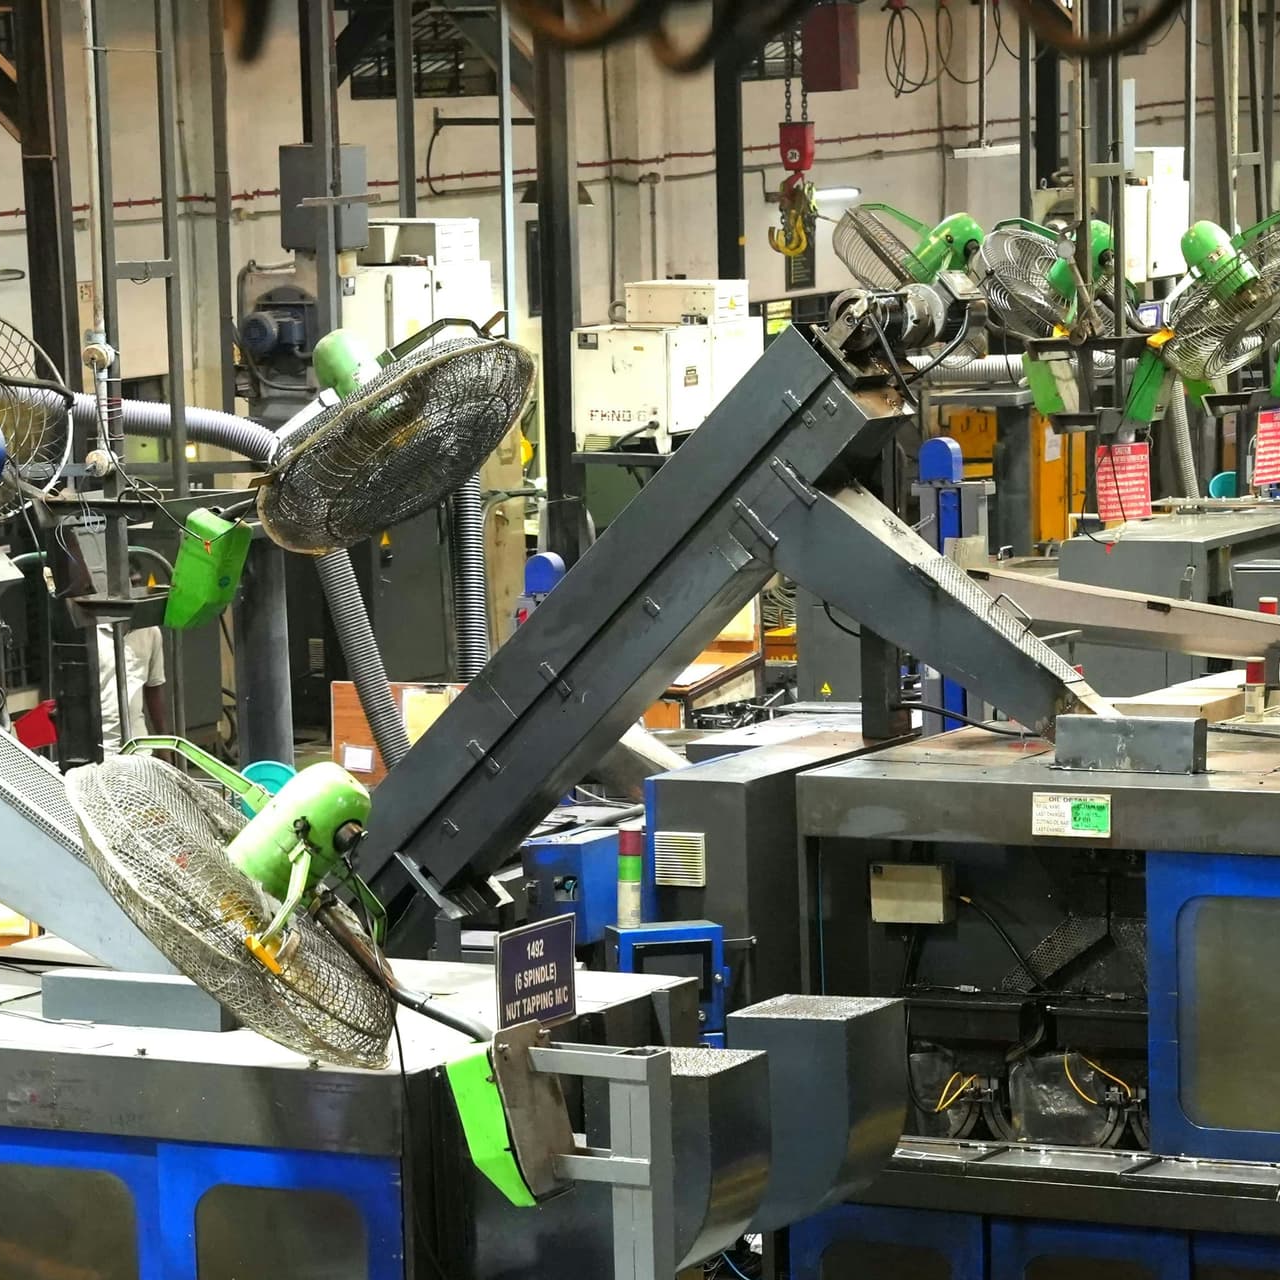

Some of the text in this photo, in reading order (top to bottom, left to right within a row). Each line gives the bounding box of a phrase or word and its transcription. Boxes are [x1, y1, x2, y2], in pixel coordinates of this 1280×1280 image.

[526, 938, 544, 961] 1492
[515, 961, 557, 995] (6 SPINDLE)
[505, 985, 569, 1022] NUT TAPPING M/C
